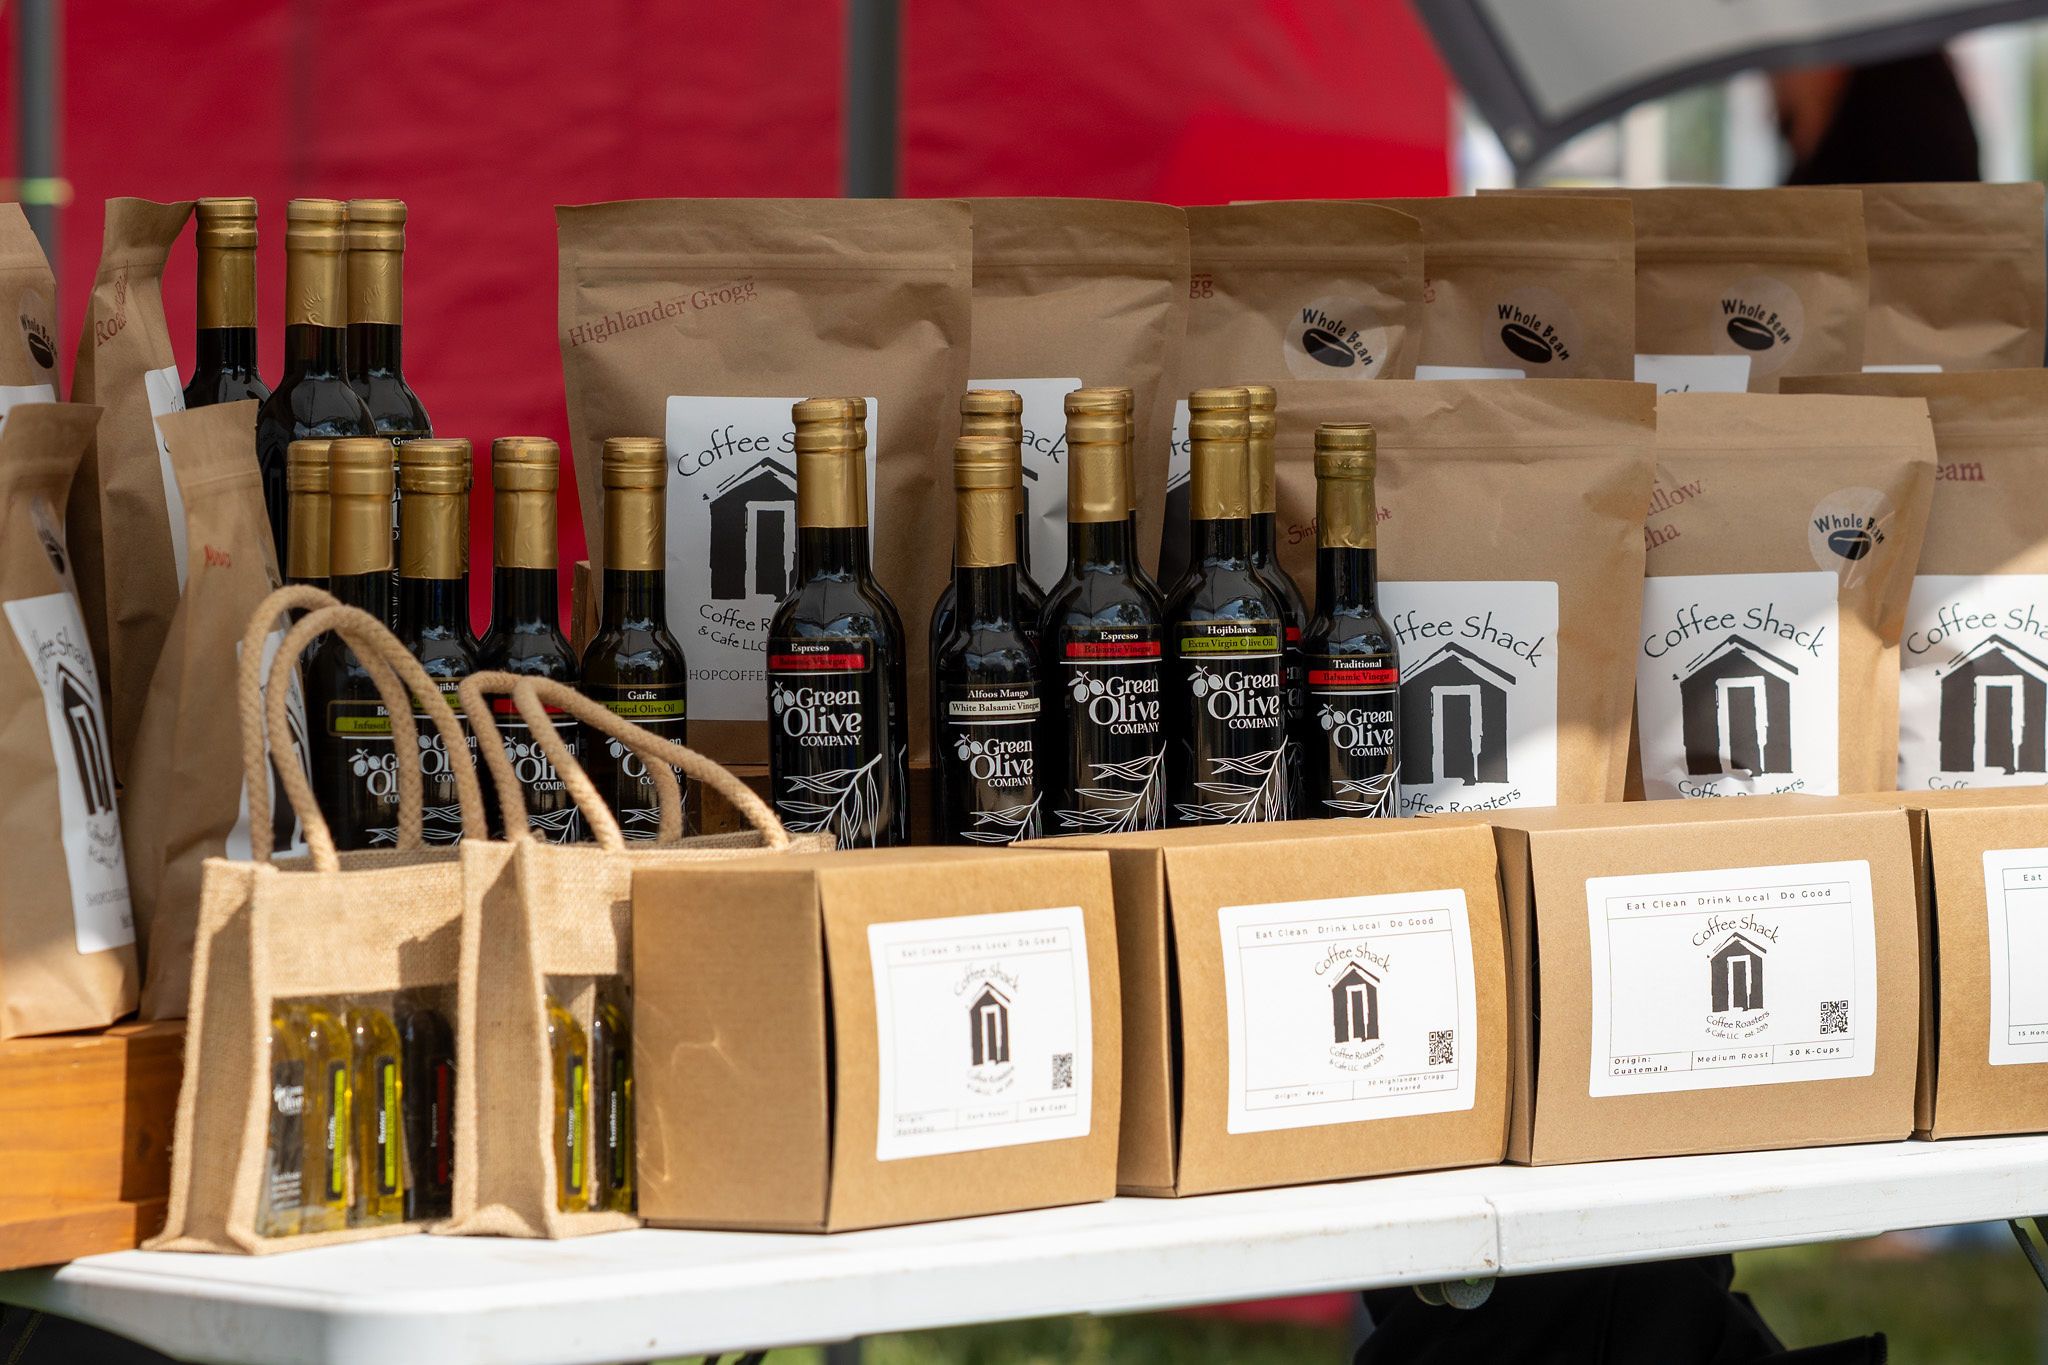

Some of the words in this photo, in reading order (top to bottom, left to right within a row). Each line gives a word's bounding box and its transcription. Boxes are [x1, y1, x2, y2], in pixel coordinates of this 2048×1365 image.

[568, 298, 686, 348] Highlander
[690, 279, 758, 311] Grogg
[1721, 298, 1766, 321] Whole
[1766, 310, 1792, 345] Bean
[1302, 307, 1346, 340] Whole
[1344, 331, 1375, 367] Bean
[1497, 303, 1542, 334] Whole
[1541, 324, 1571, 362] Bean
[677, 425, 770, 477] Coffee
[1022, 429, 1067, 464] ack
[1935, 461, 1986, 483] eam
[1647, 479, 1702, 517] allow
[1643, 523, 1681, 551] cha
[1814, 515, 1863, 535] Whole
[1867, 516, 1886, 545] Bean
[699, 604, 757, 632] Coffee
[1907, 602, 1997, 654] Coffee
[2004, 604, 2048, 641] Sha
[698, 625, 709, 636] &
[710, 630, 740, 649] Cafe
[1100, 631, 1139, 642] Espresso
[1207, 625, 1257, 637] Hojiblanca
[1393, 610, 1454, 646] ffee
[1460, 611, 1545, 668] Shack
[1644, 603, 1736, 658] Coffee
[1742, 602, 1826, 657] Shack
[791, 643, 830, 654] Espresso
[1188, 638, 1209, 649] Extra
[1210, 637, 1237, 649] Virgin
[1238, 637, 1261, 648] Olive
[1262, 637, 1273, 648] Oil
[1333, 659, 1382, 669] Traditional
[689, 669, 768, 681] HOPCOFFE
[1224, 671, 1279, 692] Green
[628, 690, 658, 701] Garlic
[968, 689, 998, 699] Alfoos
[1000, 688, 1029, 699] Mango
[1106, 676, 1159, 696] Green
[640, 704, 663, 713] Olive
[664, 703, 675, 713] Oil
[795, 687, 862, 708] Green
[952, 703, 977, 712] White
[978, 702, 1016, 712] Balsamic
[1207, 689, 1279, 720] Olive
[1089, 695, 1160, 726] Olive
[1347, 708, 1394, 726] Green
[783, 707, 863, 738] Olive
[1110, 722, 1159, 735] COMPANY
[1229, 716, 1279, 729] COMPANY
[800, 735, 862, 747] COMPANY
[984, 738, 1033, 756] Green
[1333, 724, 1394, 749] Olive
[1350, 746, 1394, 757] COMPANY
[515, 757, 557, 784] Oli
[969, 755, 1033, 780] Olive
[533, 781, 568, 791] COMPA
[988, 776, 1033, 787] COMPANY
[1401, 793, 1444, 814] offee
[2023, 874, 2043, 882] Eat
[1626, 902, 1647, 911] Eat
[1652, 899, 1687, 909] Clean
[1698, 896, 1732, 906] Drink
[1738, 893, 1770, 903] Local
[1780, 891, 1796, 900] Do
[1801, 889, 1832, 899] Good
[1256, 930, 1272, 940] Eat
[1278, 927, 1308, 937] Clean
[1318, 924, 1348, 935] Drink
[1353, 921, 1381, 931] Local
[1390, 919, 1404, 928] Do
[1408, 917, 1435, 927] Good
[1692, 914, 1737, 947] Coffee
[1739, 913, 1779, 944] Shack
[1314, 943, 1353, 976] Coffee
[1355, 942, 1391, 974] Shack
[1706, 1015, 1734, 1029] Coffee
[1735, 1011, 1770, 1029] Roasters
[1329, 1046, 1354, 1061] Coffee
[1355, 1042, 1386, 1060] Roasters
[1614, 1056, 1652, 1065] Origin:
[1698, 1053, 1736, 1063] Medium
[1741, 1050, 1769, 1060] Roast
[1805, 1047, 1841, 1056] K-Cups
[1614, 1065, 1669, 1075] Guatemala
[1388, 1084, 1421, 1092] Flavored
